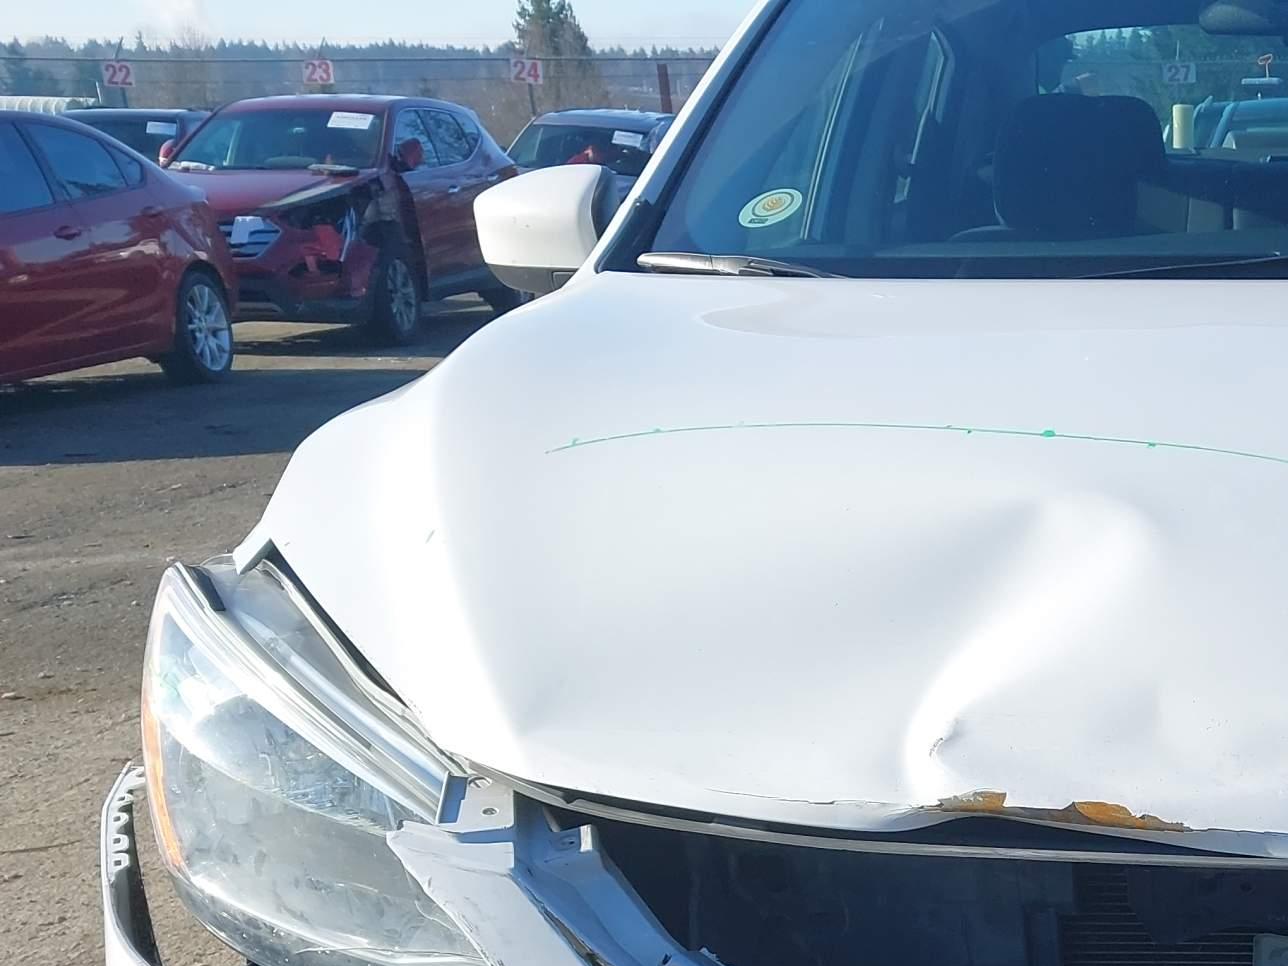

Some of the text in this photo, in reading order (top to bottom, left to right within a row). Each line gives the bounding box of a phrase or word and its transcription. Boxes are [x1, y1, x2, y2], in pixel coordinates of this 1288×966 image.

[105, 63, 133, 86] 22
[304, 61, 331, 83] 23
[513, 60, 540, 82] 24
[1166, 65, 1190, 82] 27
